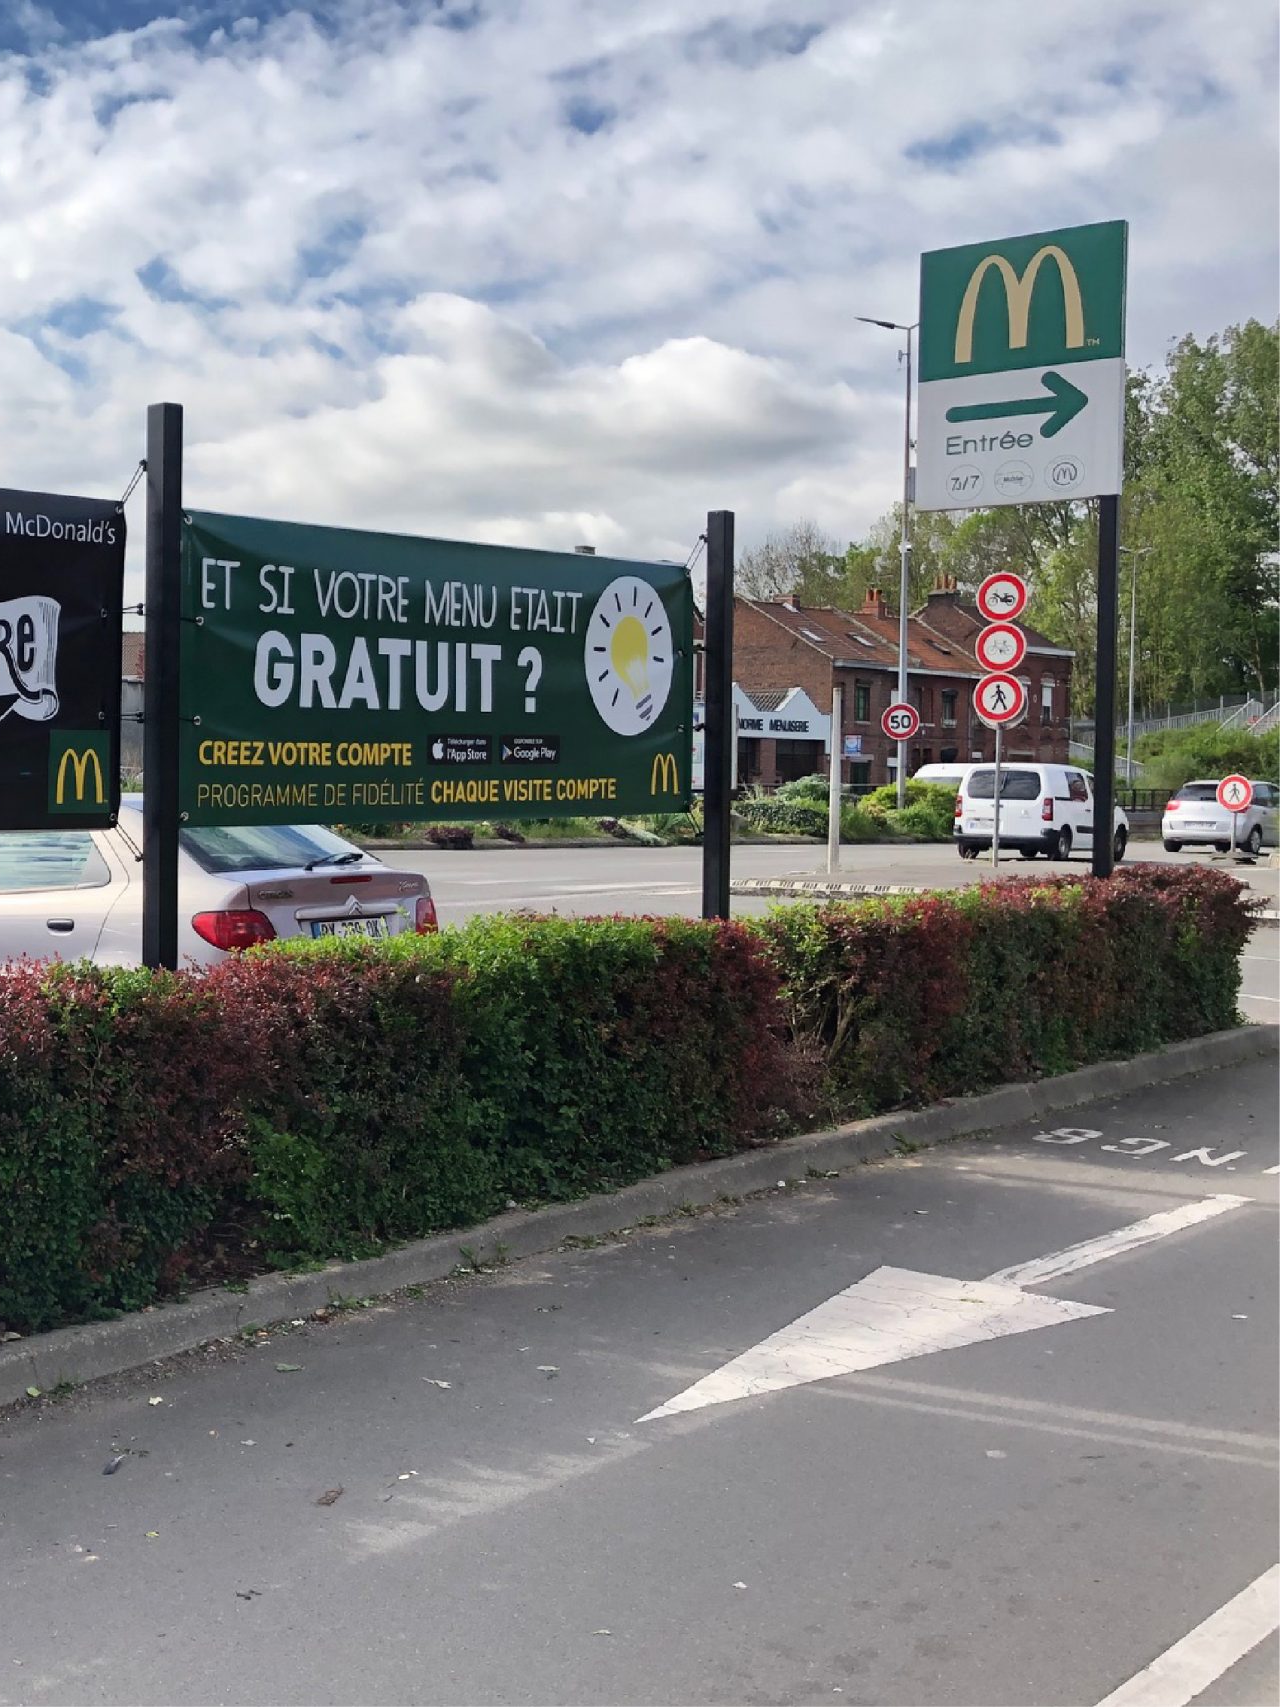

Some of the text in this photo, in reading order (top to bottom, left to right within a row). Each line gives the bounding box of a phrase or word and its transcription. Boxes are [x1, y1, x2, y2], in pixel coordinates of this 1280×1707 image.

[946, 431, 1033, 456] Entrée
[5, 511, 116, 544] McDonald's
[202, 557, 241, 610] ET
[258, 564, 295, 615] SI
[313, 568, 410, 623] VOTRE
[424, 579, 497, 628] MENU
[509, 586, 583, 634] ETAIT
[254, 630, 543, 713] GRATUIT ?
[889, 713, 913, 730] 50
[198, 740, 412, 766] CREEZ VOTRE COMPTE
[447, 748, 487, 762] l'App Store
[513, 746, 557, 761] Google Play
[197, 777, 616, 808] PROGRAMME DE FIDÉLITÉ CHAQUE VISITE COMPTE
